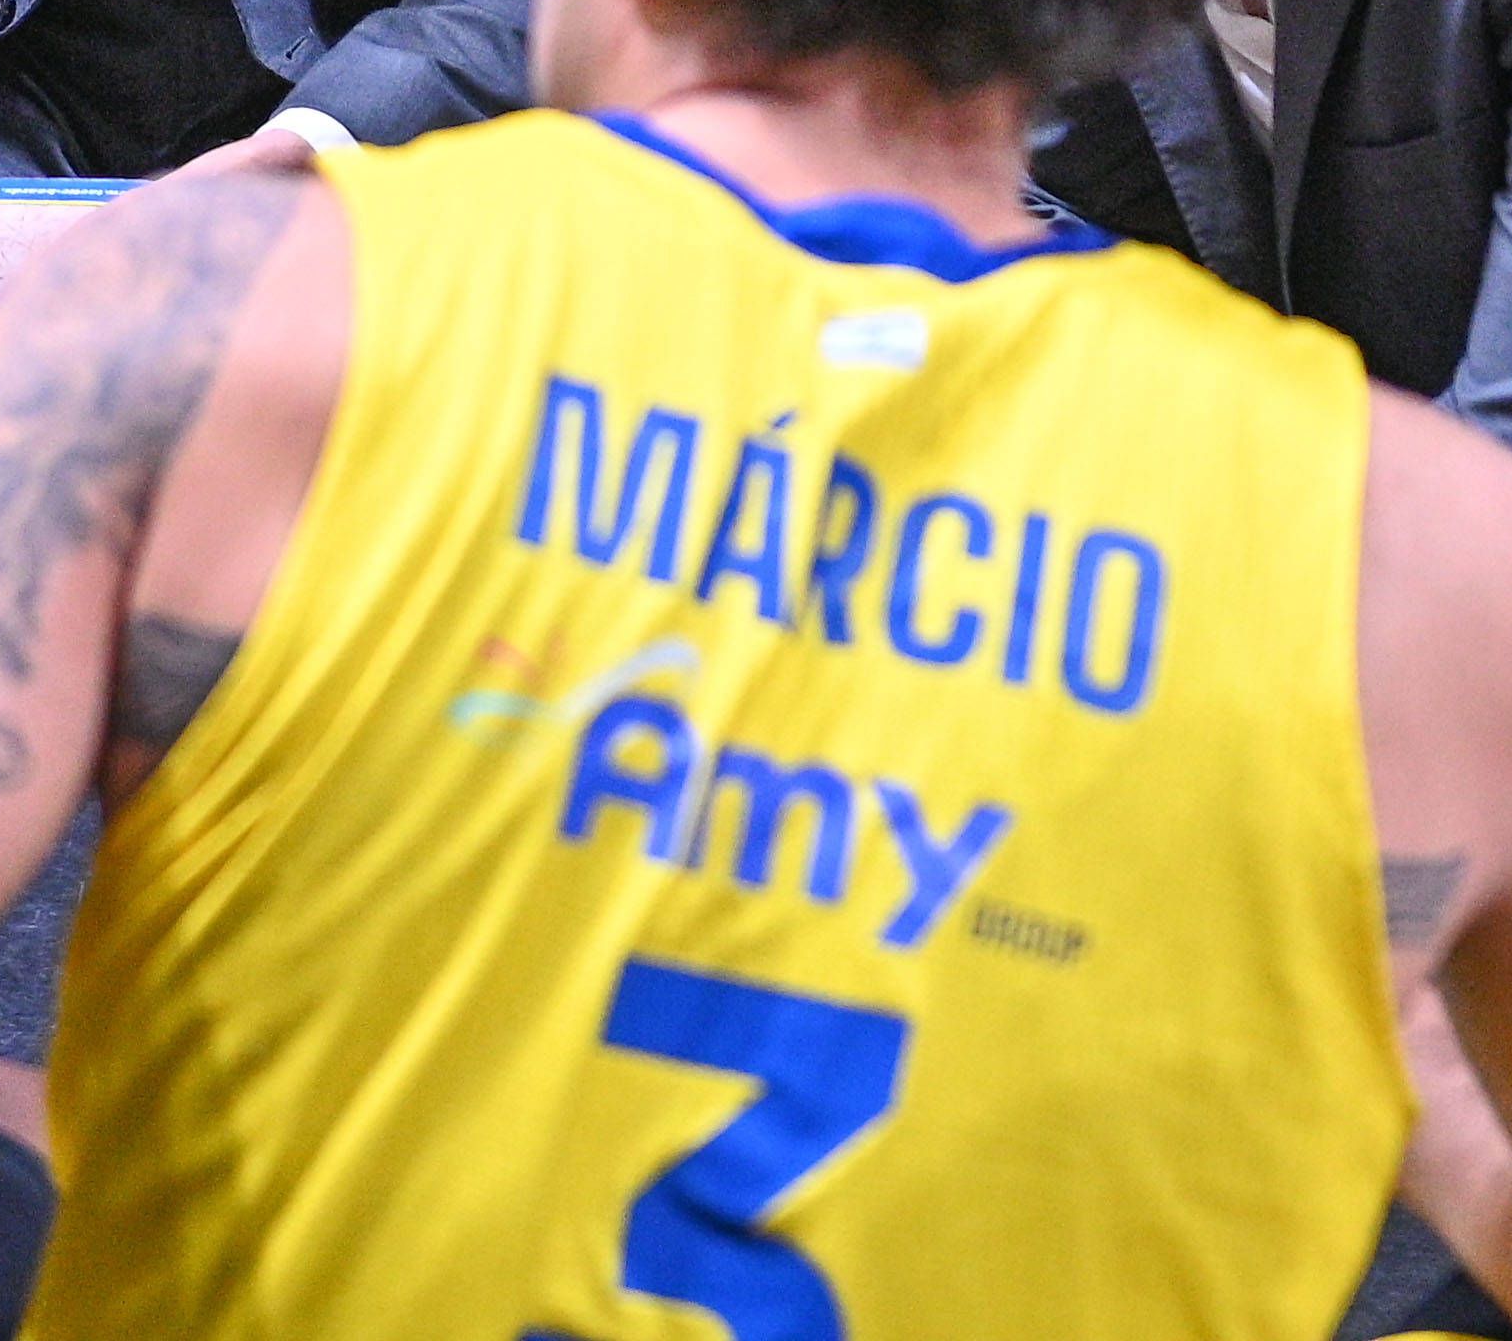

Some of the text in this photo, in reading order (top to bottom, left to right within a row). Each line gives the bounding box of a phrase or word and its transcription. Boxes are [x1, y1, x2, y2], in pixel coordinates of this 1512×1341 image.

[514, 372, 1168, 714] MÁRCIO
[556, 690, 1016, 952] Amy
[512, 953, 912, 1341] 3
